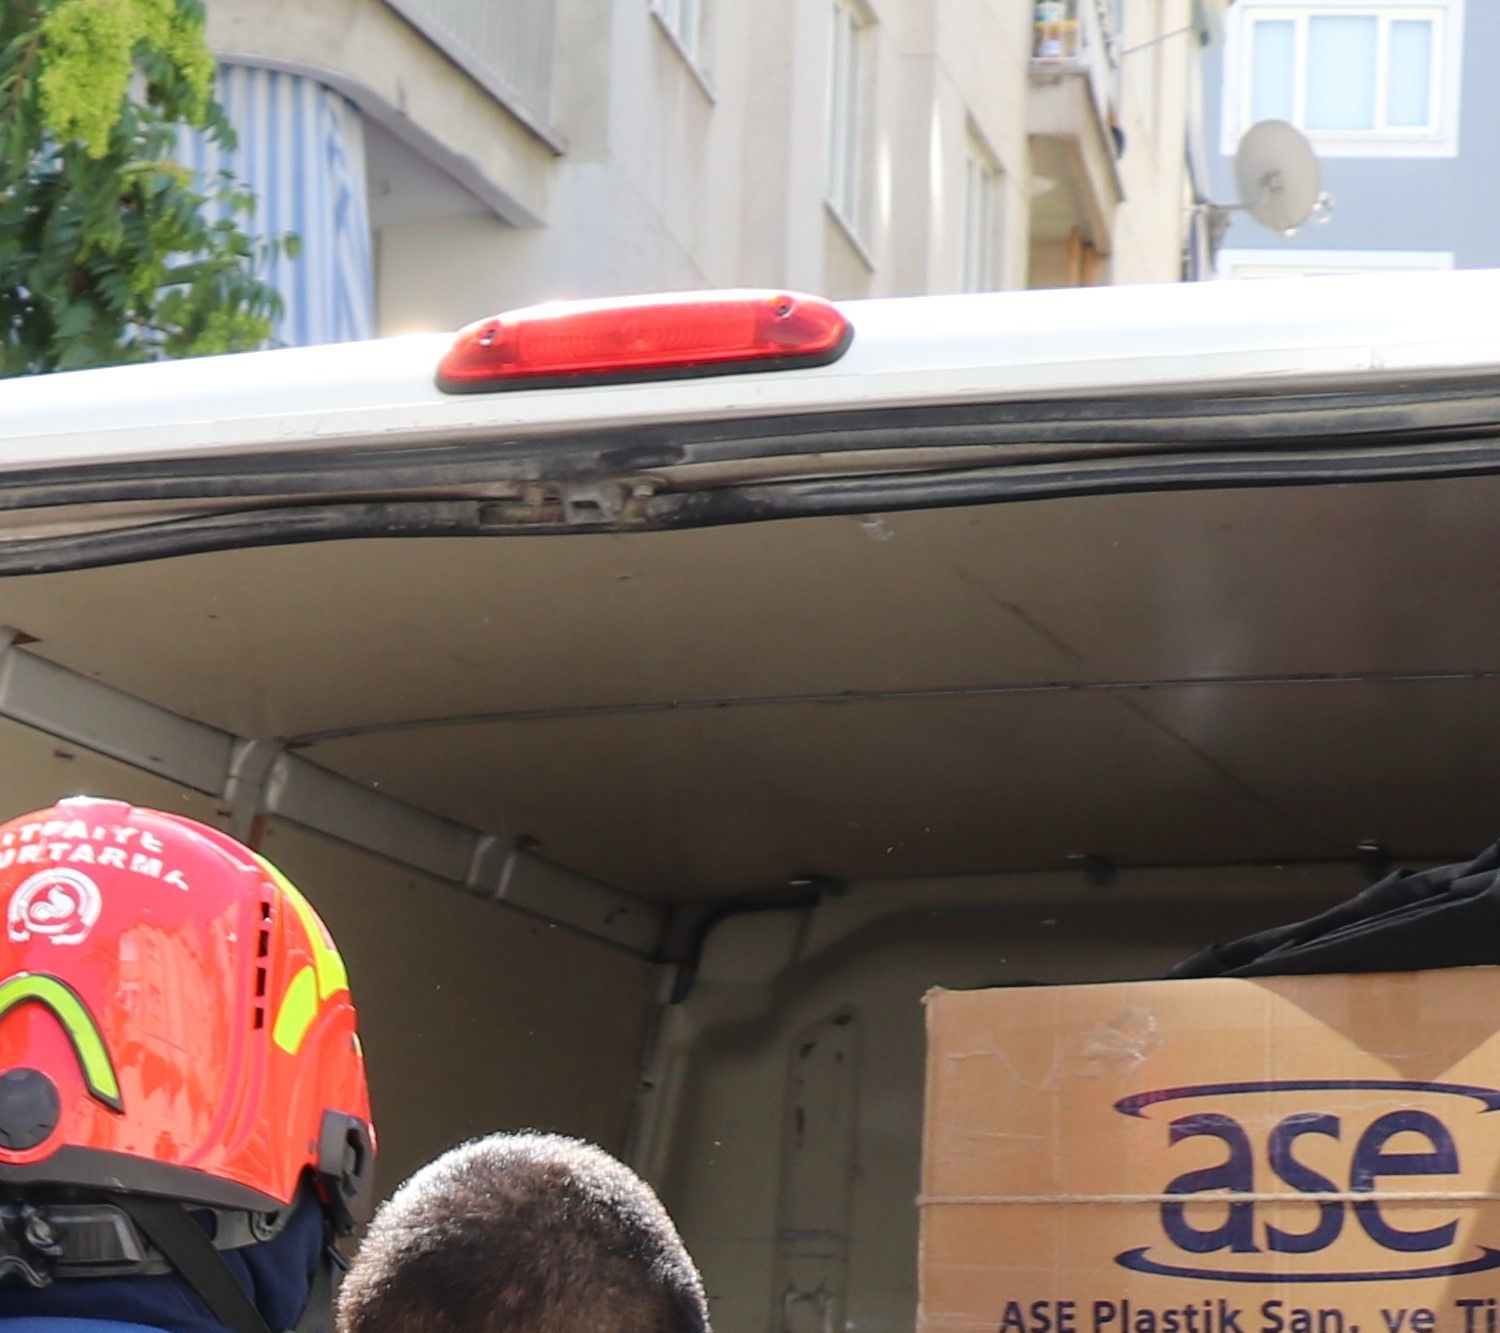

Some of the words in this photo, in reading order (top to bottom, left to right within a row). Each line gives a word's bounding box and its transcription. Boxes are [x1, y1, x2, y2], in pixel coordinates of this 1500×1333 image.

[1160, 1108, 1460, 1255] ase
[998, 1300, 1077, 1333] ASE
[1092, 1299, 1244, 1333] Plastik
[1260, 1300, 1360, 1333] San.
[1380, 1307, 1437, 1333] ve
